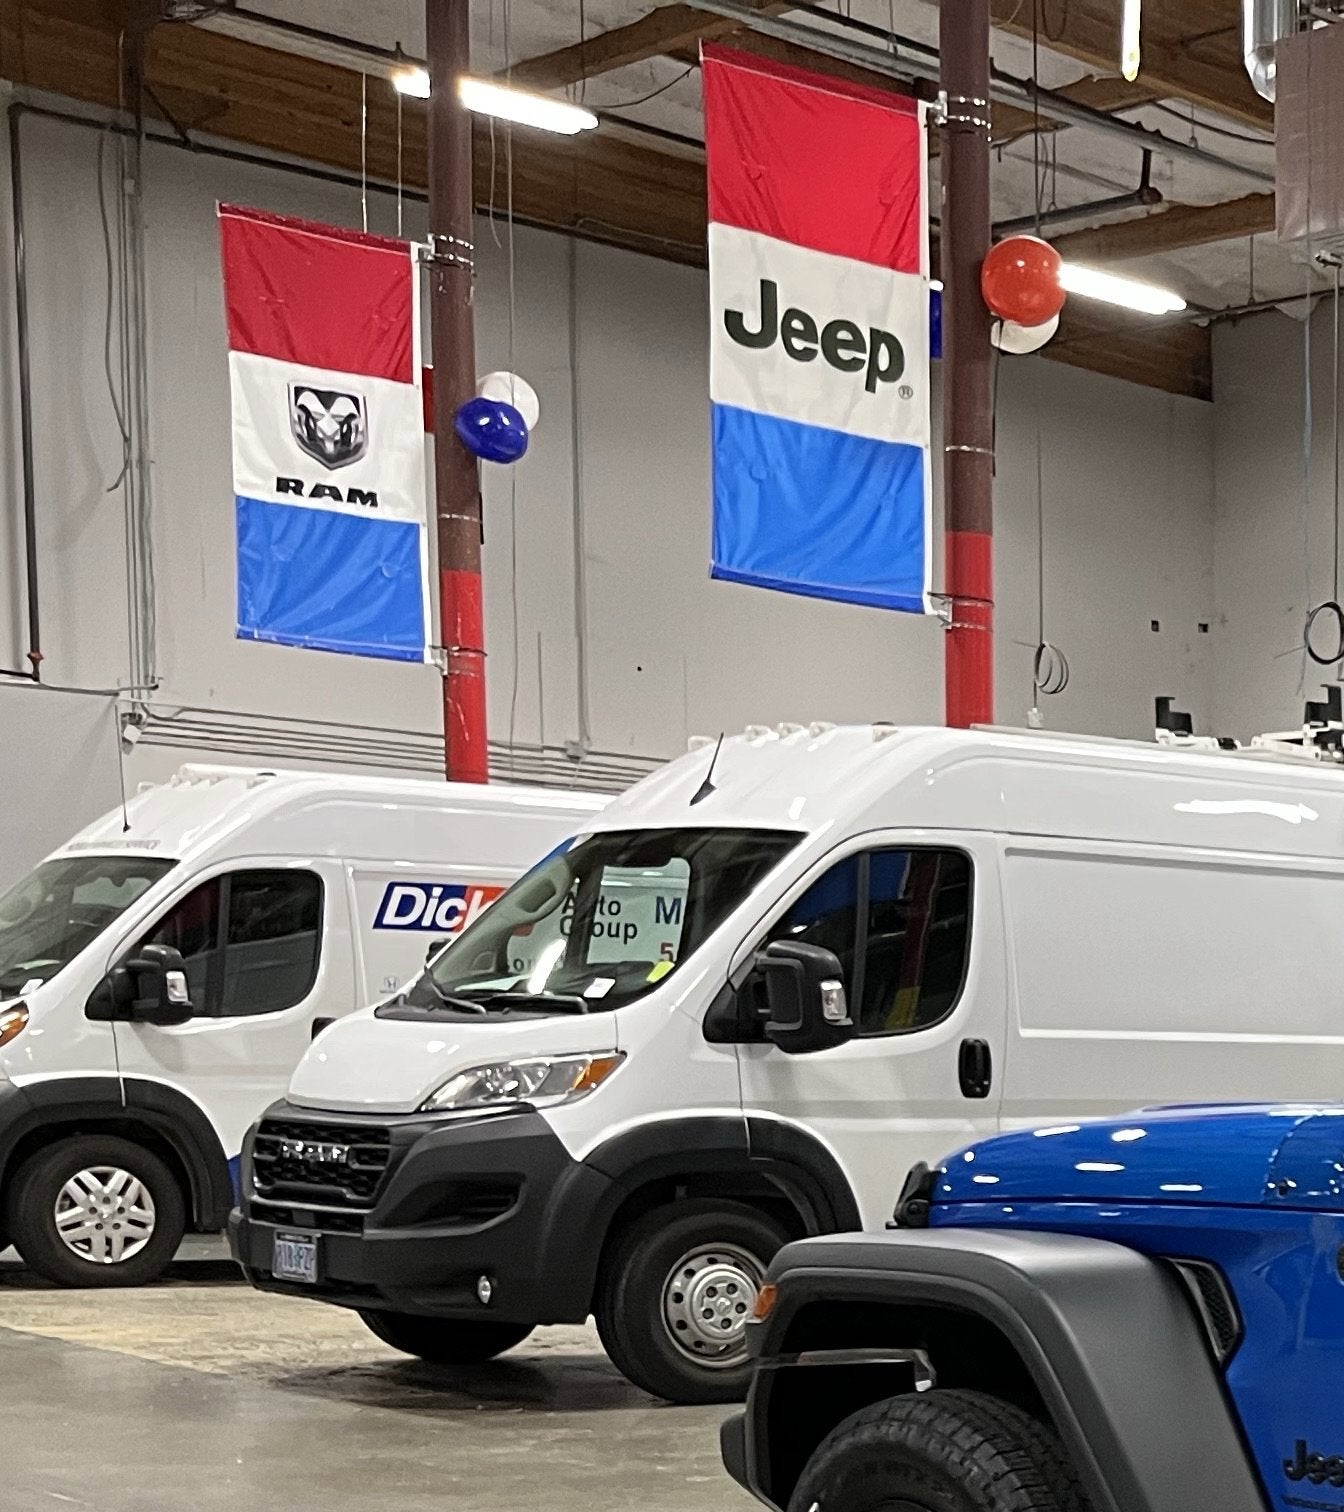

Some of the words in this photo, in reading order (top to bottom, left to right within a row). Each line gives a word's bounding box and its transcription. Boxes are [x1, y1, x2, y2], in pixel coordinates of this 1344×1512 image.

[723, 278, 906, 395] Jeep
[275, 475, 379, 508] RAM
[561, 892, 622, 917] Ato
[559, 914, 638, 945] Goup
